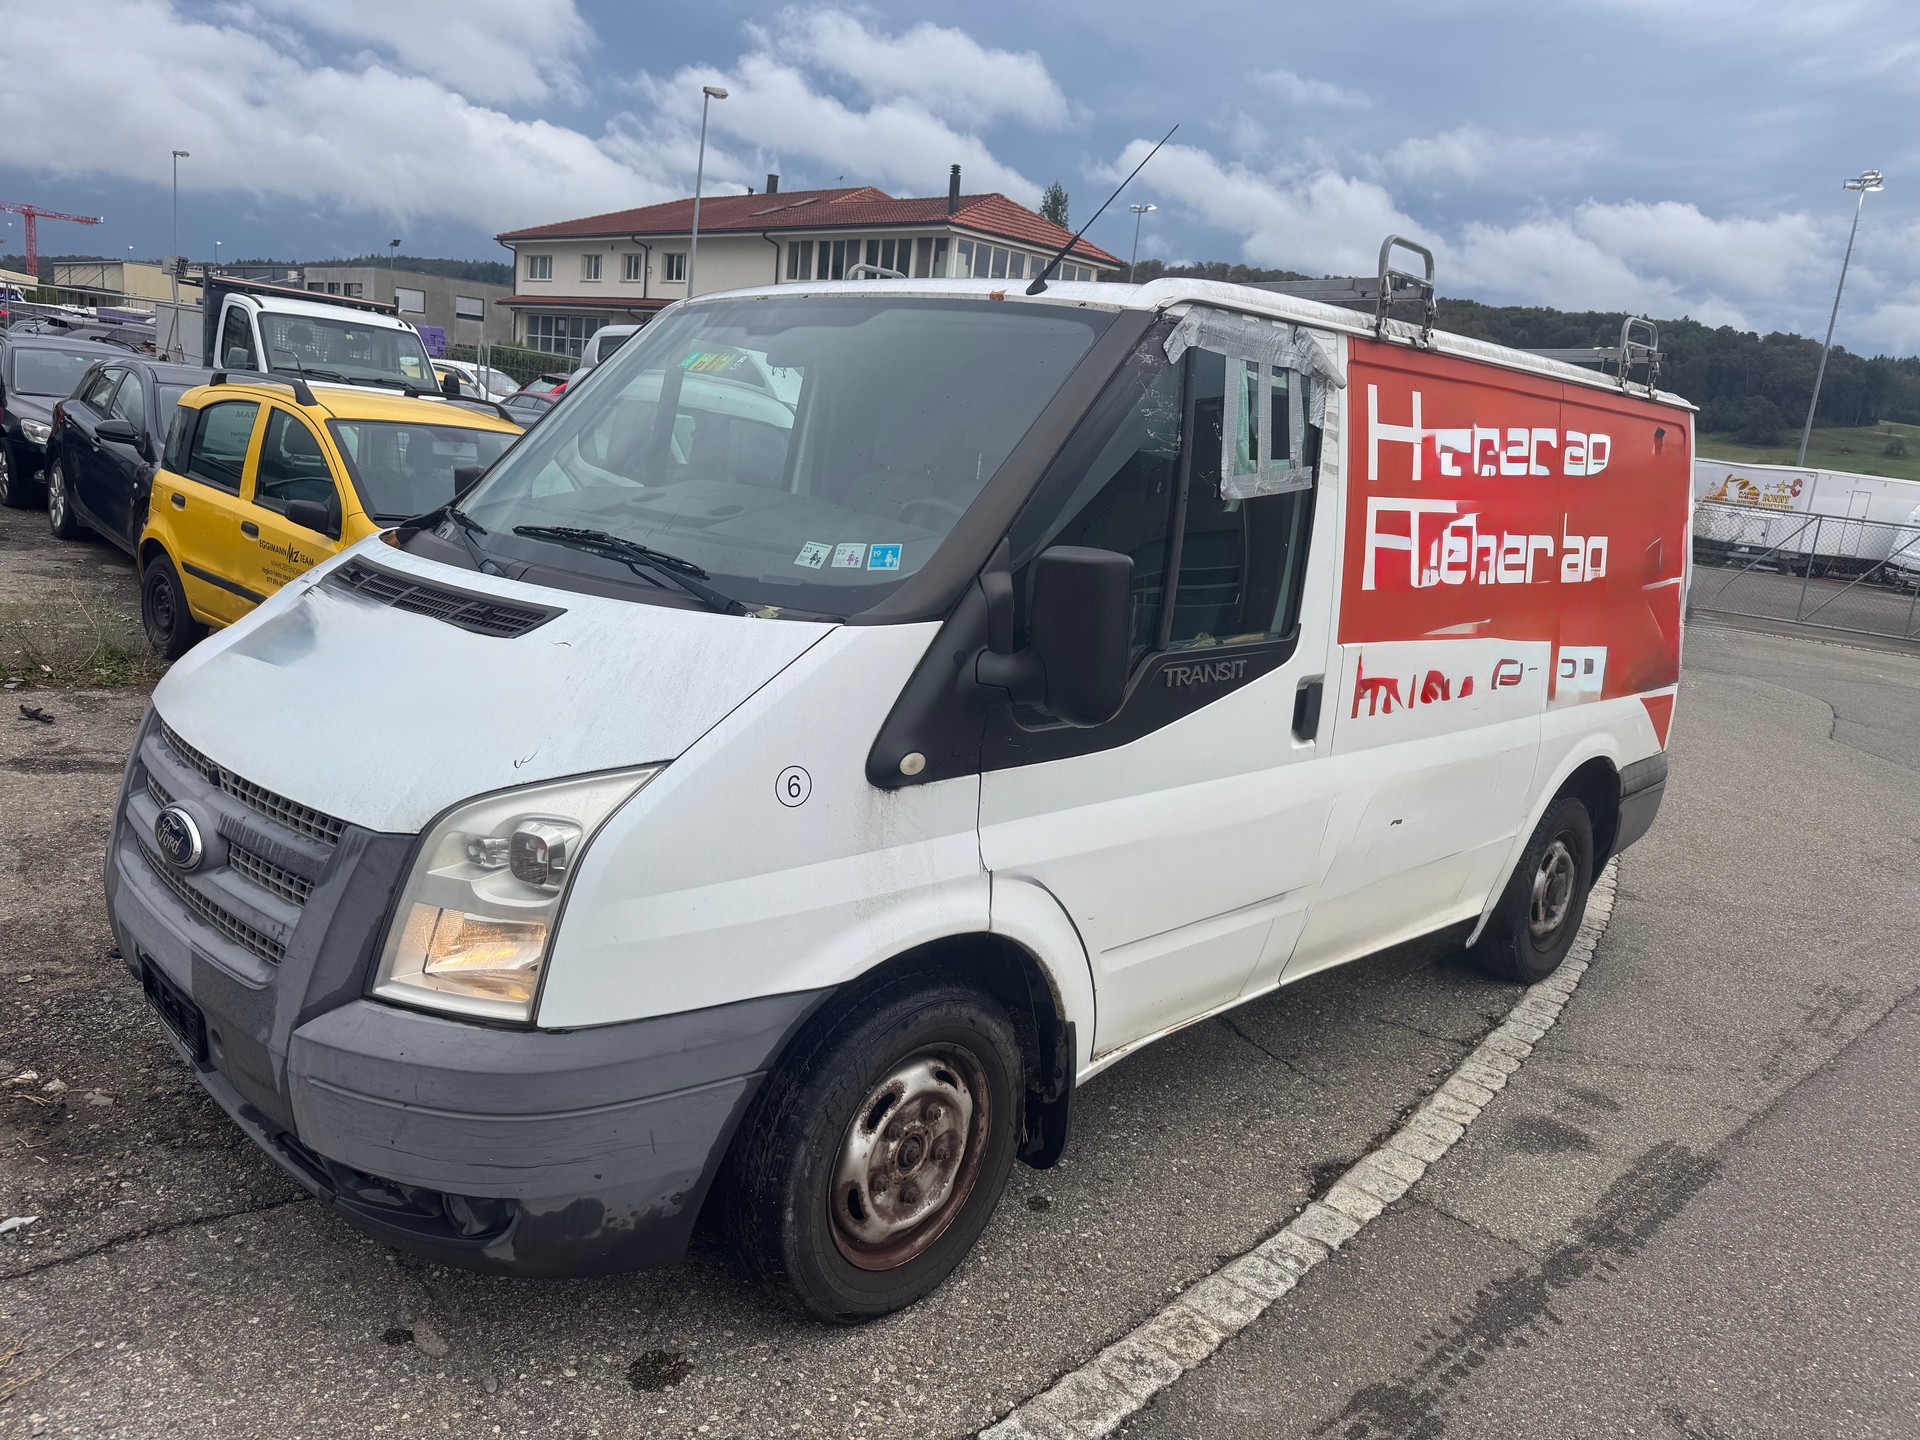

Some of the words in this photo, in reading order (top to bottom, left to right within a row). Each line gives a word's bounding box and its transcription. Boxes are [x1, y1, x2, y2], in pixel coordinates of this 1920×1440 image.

[259, 539, 287, 557] EGGIMANN
[299, 554, 315, 566] TEAM
[1163, 660, 1248, 688] TRANSIT
[787, 774, 802, 798] 6
[157, 816, 184, 855] Ford
